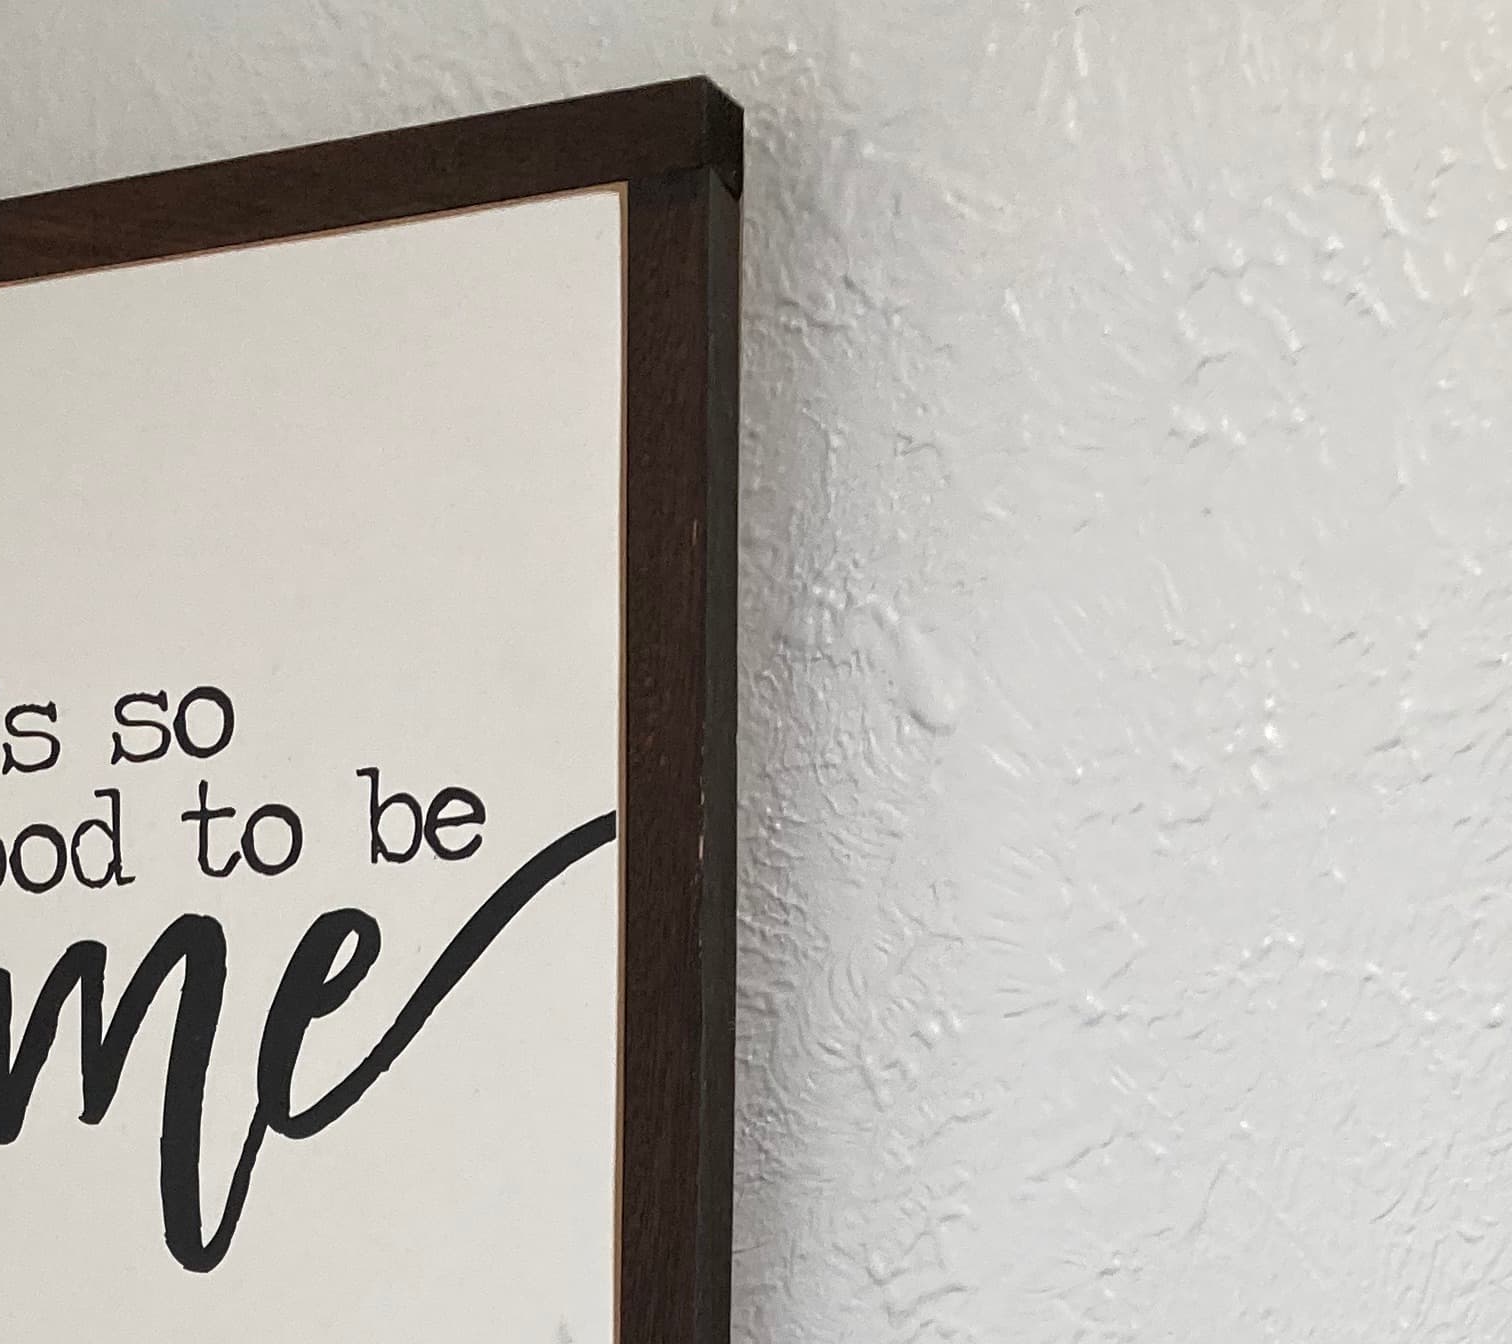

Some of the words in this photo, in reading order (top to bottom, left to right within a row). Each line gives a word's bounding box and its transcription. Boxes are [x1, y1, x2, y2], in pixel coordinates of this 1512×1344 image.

[110, 686, 235, 765] so
[181, 779, 303, 878] to
[356, 767, 486, 864] be
